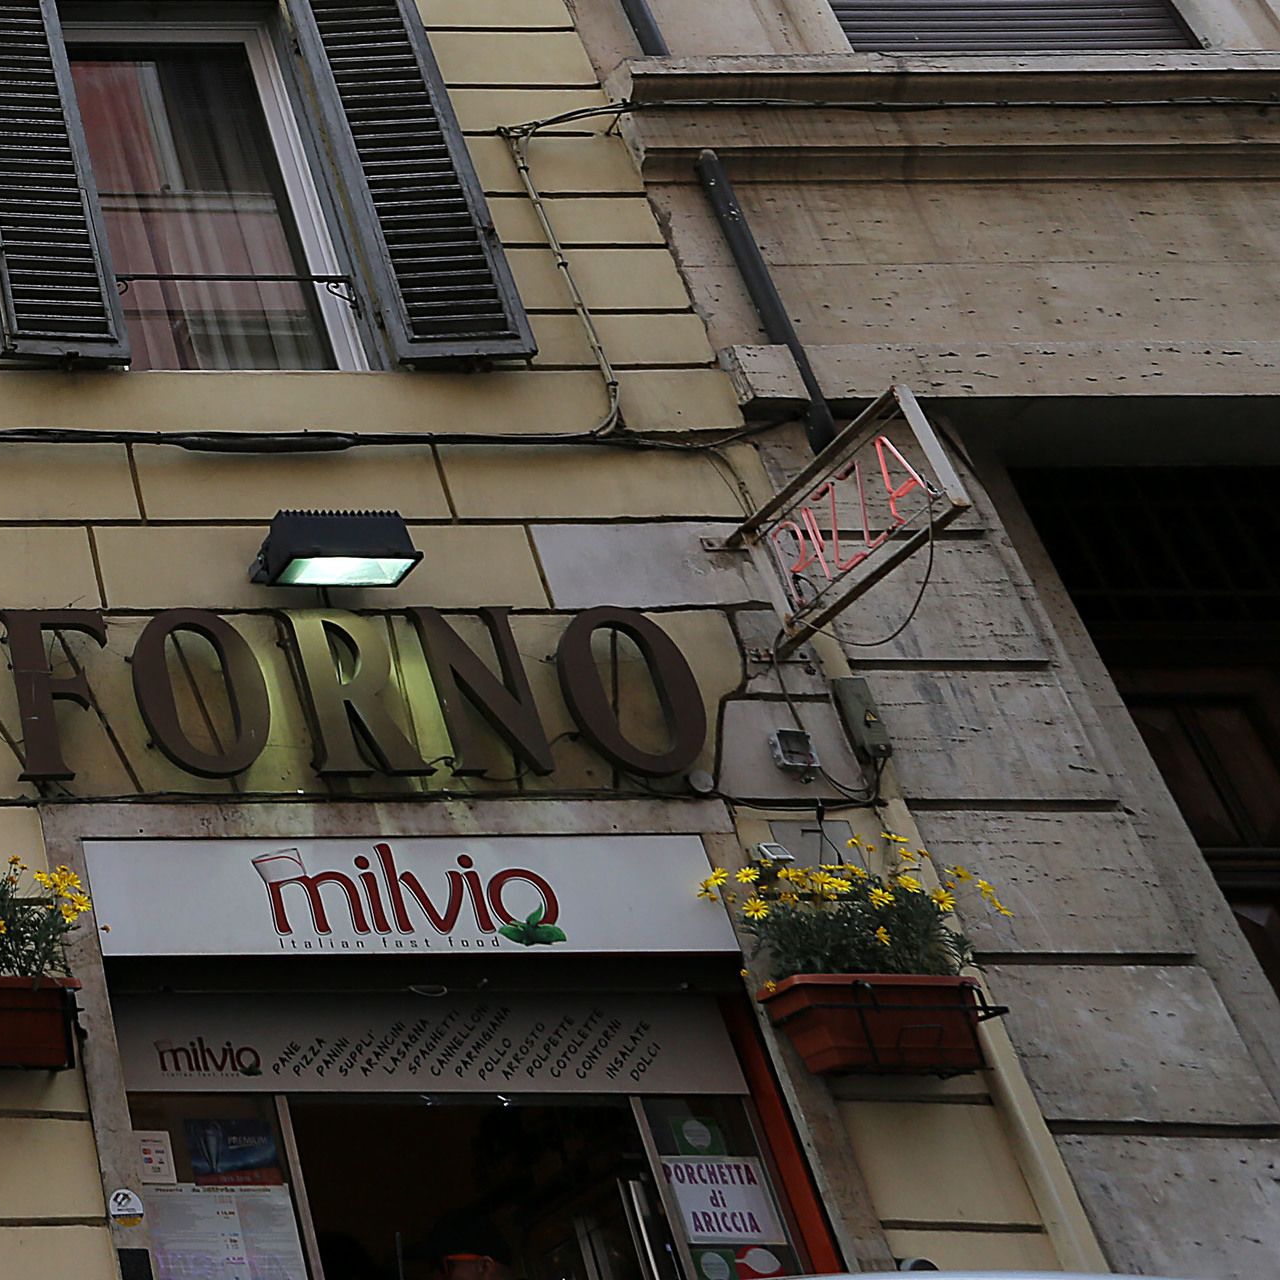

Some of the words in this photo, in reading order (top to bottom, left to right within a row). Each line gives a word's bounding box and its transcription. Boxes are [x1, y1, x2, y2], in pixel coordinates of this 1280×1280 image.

[772, 434, 926, 606] PIZZA
[265, 842, 560, 936] milvio
[279, 937, 365, 949] Italian
[382, 937, 431, 949] fast
[447, 936, 500, 948] food
[158, 1036, 261, 1072] milvio
[272, 1040, 301, 1075] PANE
[292, 1037, 327, 1077] PIZZA
[316, 1036, 350, 1077] PANINI
[359, 1020, 407, 1077] ARANCINI
[383, 1018, 430, 1075] LASAGNA
[408, 1009, 460, 1075] SPAGHETTI
[455, 1005, 512, 1078] PARMIGIANA
[478, 1037, 512, 1081] POLLO
[501, 1022, 546, 1081] ARROSTO
[526, 1014, 575, 1078] POLPETTE
[550, 1007, 604, 1078] COTOLETTE
[575, 1018, 622, 1080] CONTORNI
[605, 1020, 651, 1079] INSALATE
[630, 1041, 662, 1082] DOLCI
[661, 1163, 758, 1185] PORCHETTA
[709, 1189, 726, 1208] di
[691, 1211, 761, 1233] ARICCIA
